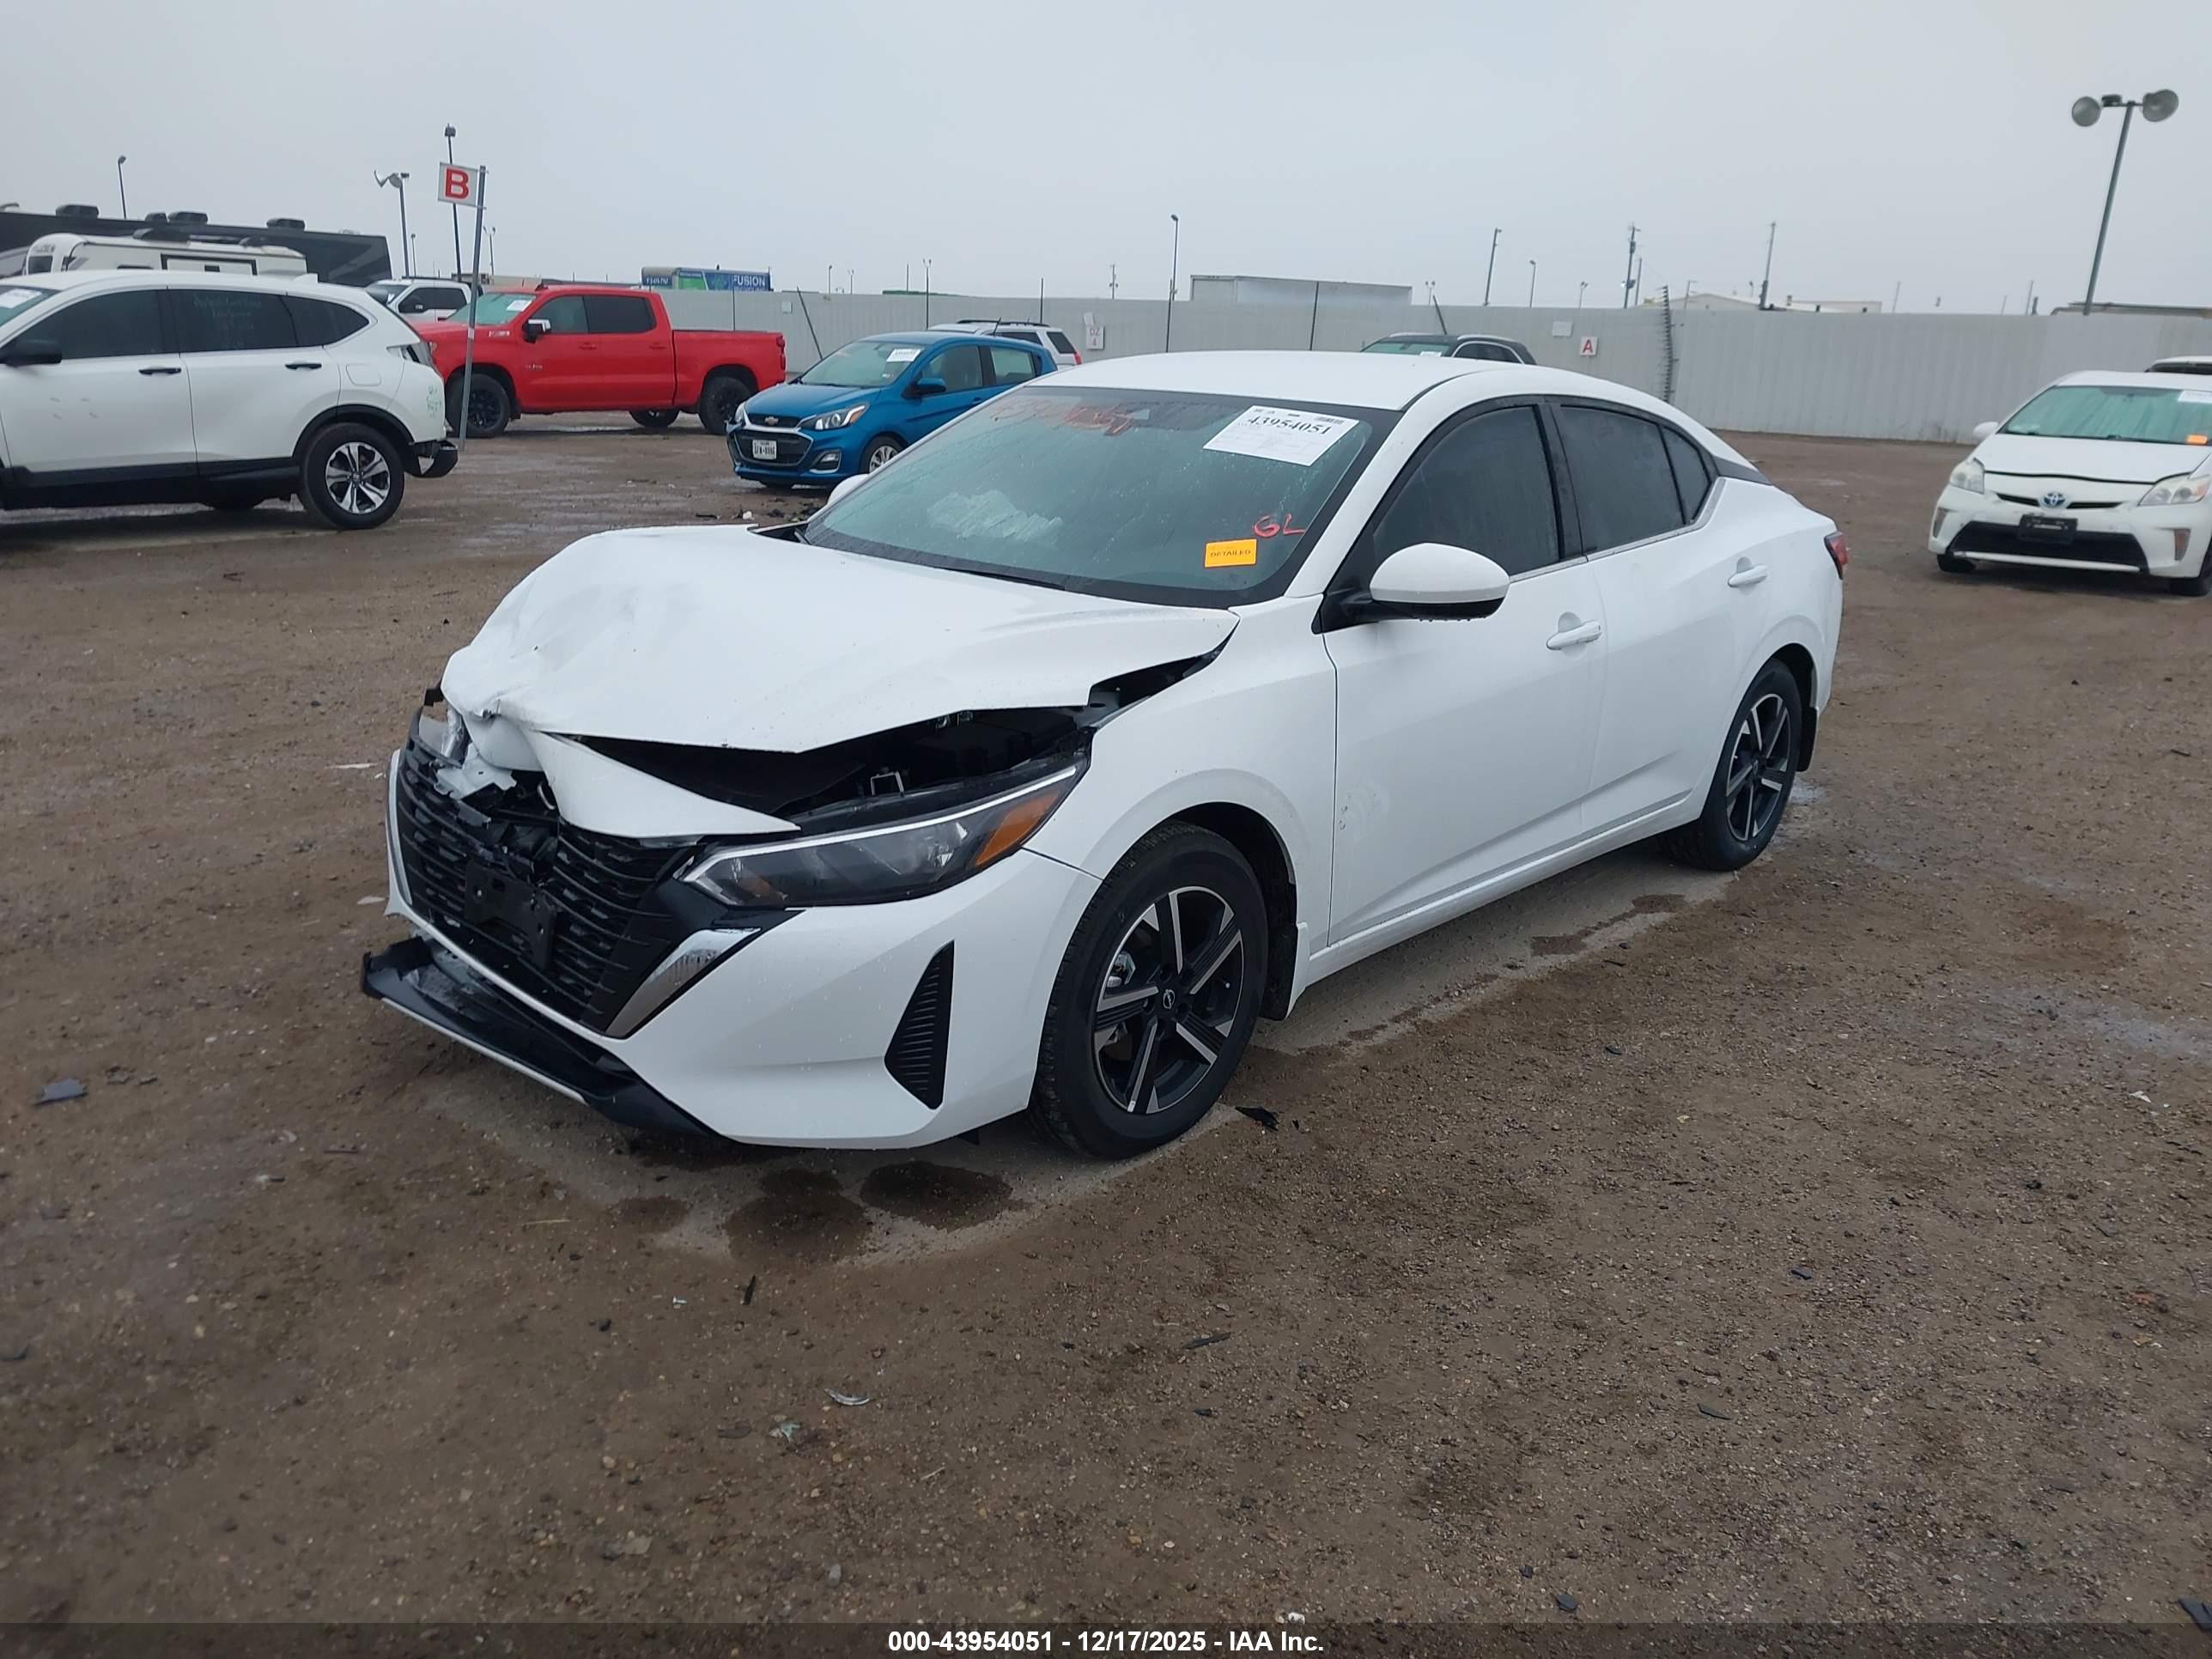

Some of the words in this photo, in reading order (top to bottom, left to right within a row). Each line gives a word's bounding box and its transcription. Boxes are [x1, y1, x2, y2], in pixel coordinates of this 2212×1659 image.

[445, 168, 470, 199] B
[733, 274, 766, 288] FUSION
[1582, 338, 1594, 354] A
[1247, 415, 1333, 434] 43954051
[1254, 514, 1305, 538] GL
